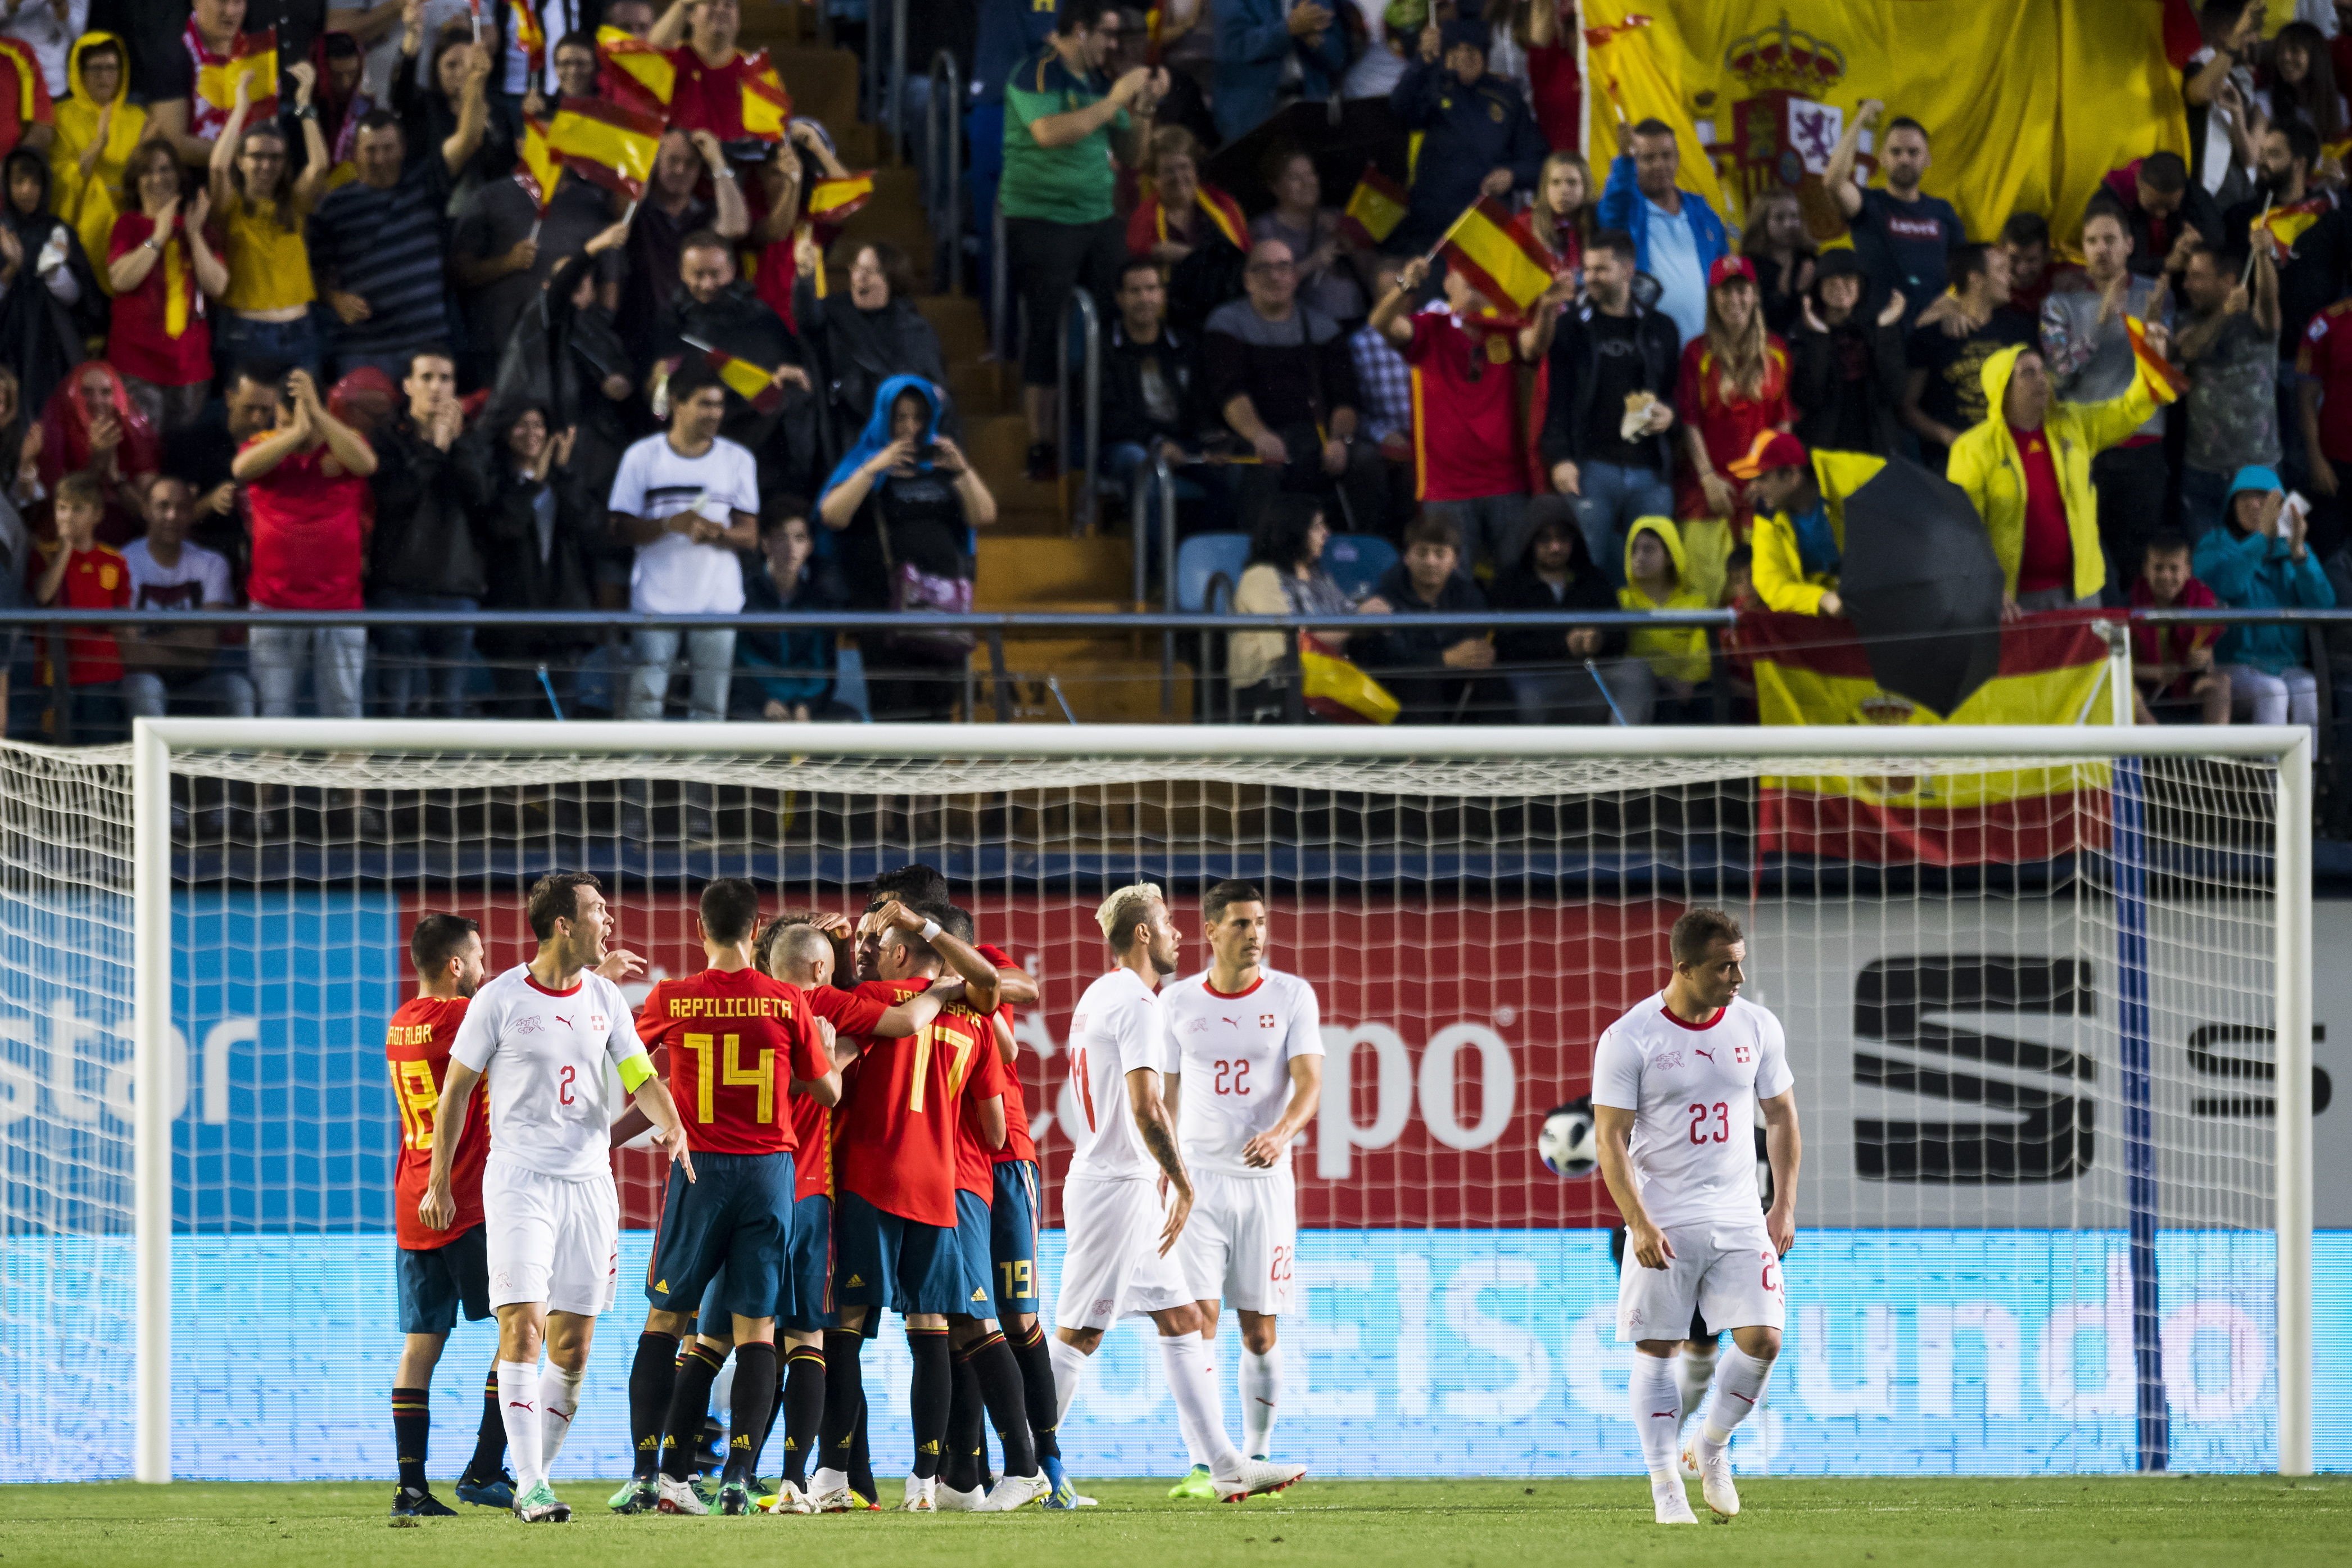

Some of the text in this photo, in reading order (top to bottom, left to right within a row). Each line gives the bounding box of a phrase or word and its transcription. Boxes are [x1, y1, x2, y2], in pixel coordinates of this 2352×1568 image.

[669, 997, 792, 1019] AZPILICUETA
[405, 1023, 433, 1046] ALBA
[559, 1065, 575, 1105] 2
[683, 1032, 776, 1123] 14
[910, 1023, 974, 1113] 17
[1214, 1059, 1250, 1096] 22
[388, 1059, 439, 1150] 18
[1689, 1102, 1729, 1145] 23
[1000, 1260, 1034, 1299] 19
